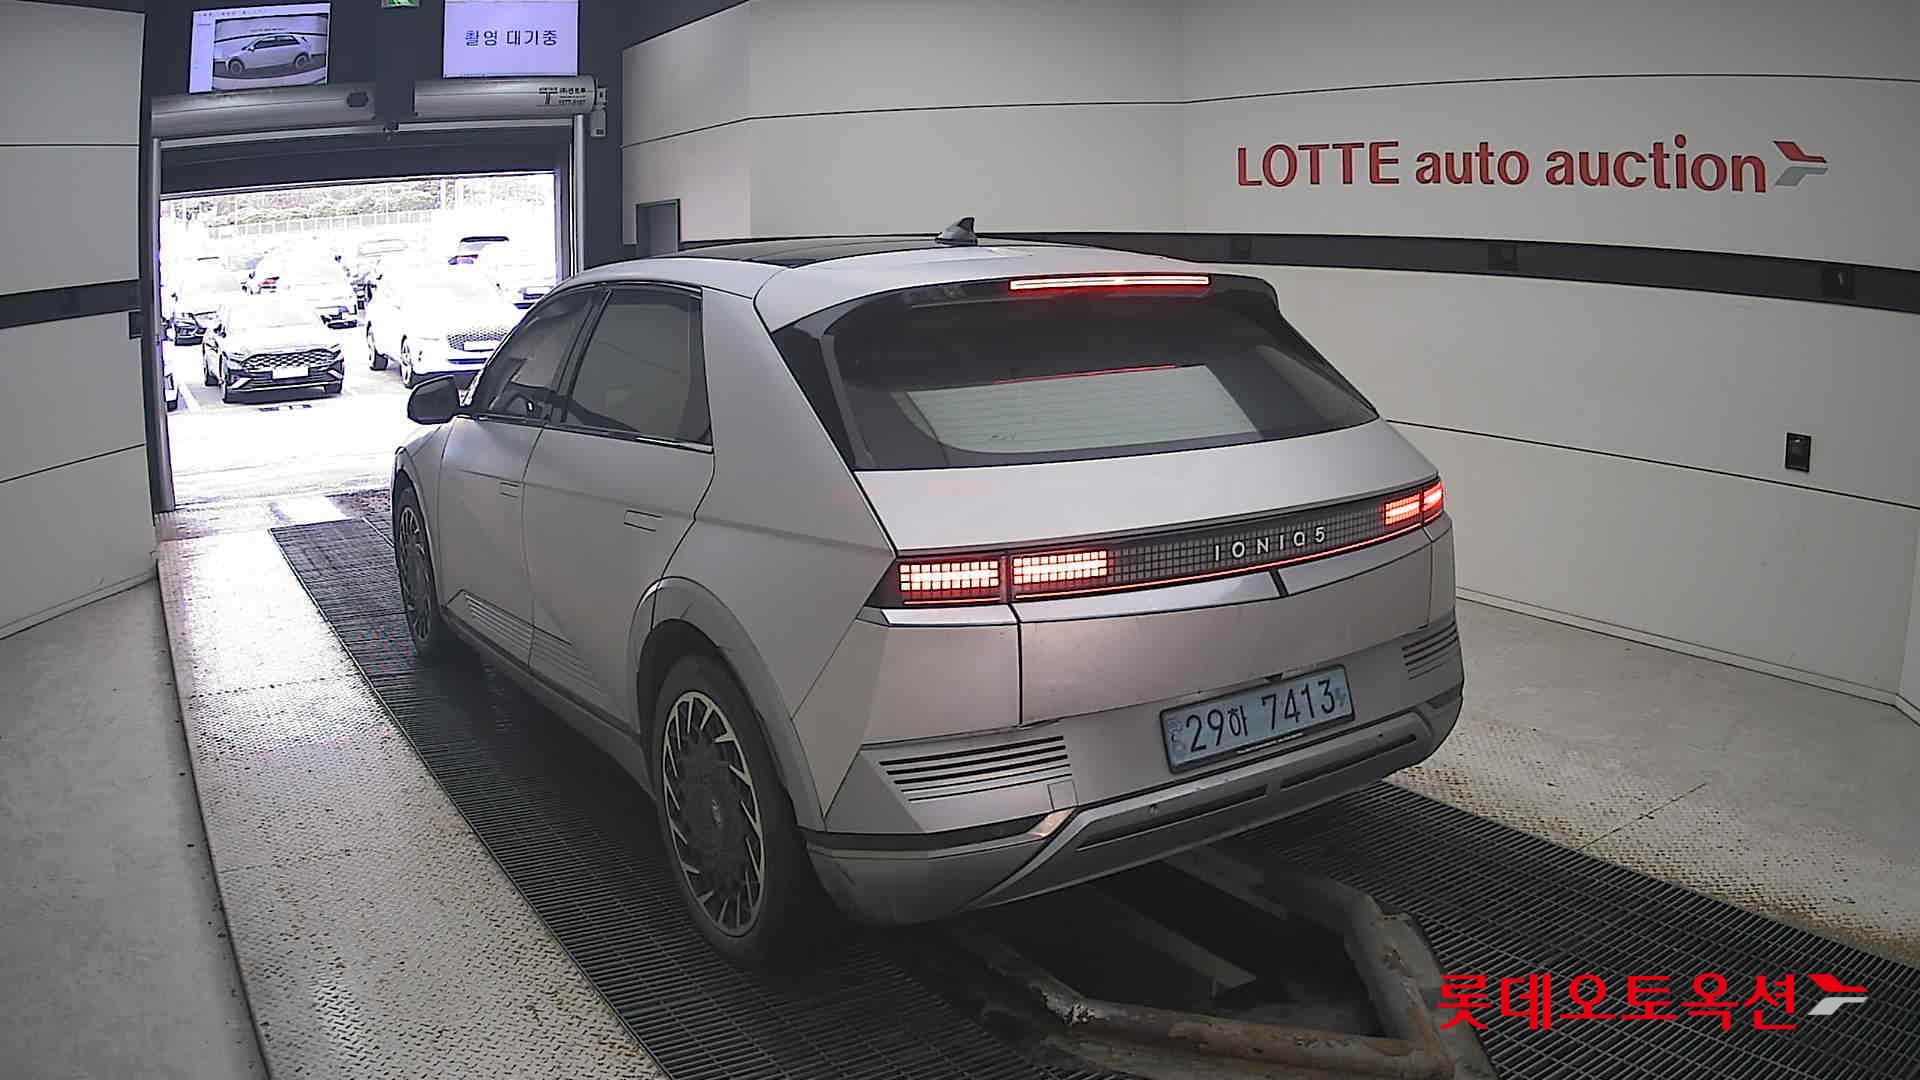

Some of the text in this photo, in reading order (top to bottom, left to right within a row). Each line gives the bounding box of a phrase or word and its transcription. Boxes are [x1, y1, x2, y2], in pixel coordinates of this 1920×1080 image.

[465, 30, 557, 47] 촬영 대기중
[1236, 134, 1766, 193] LOTTE auto auction
[1186, 679, 1336, 753] 29하 7413
